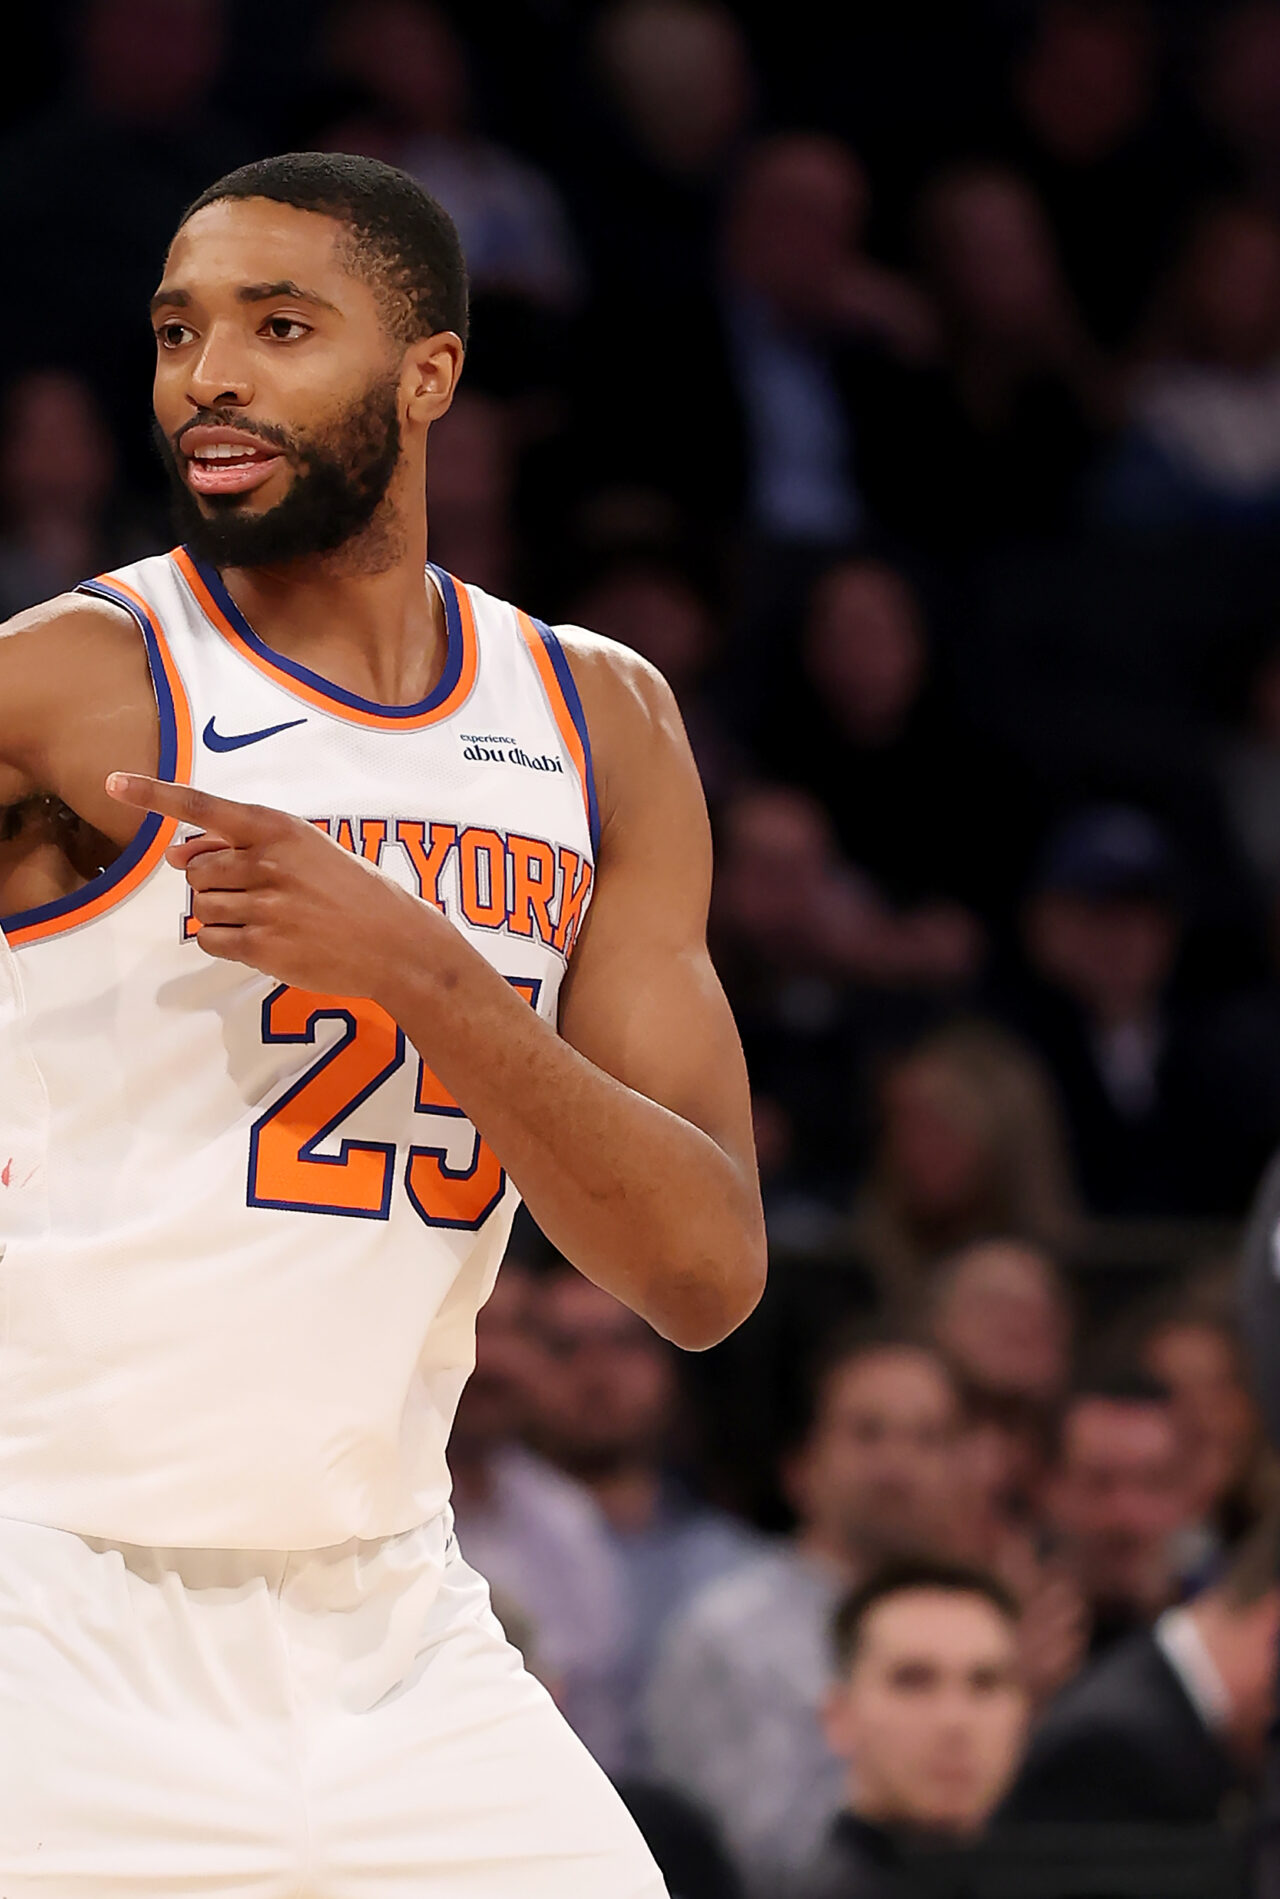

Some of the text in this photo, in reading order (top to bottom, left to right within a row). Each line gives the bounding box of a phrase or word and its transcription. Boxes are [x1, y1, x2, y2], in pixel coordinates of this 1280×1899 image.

[460, 734, 516, 745] experience
[463, 745, 564, 773] abu dhabi
[395, 818, 594, 960] YORK
[246, 975, 543, 1231] 25
